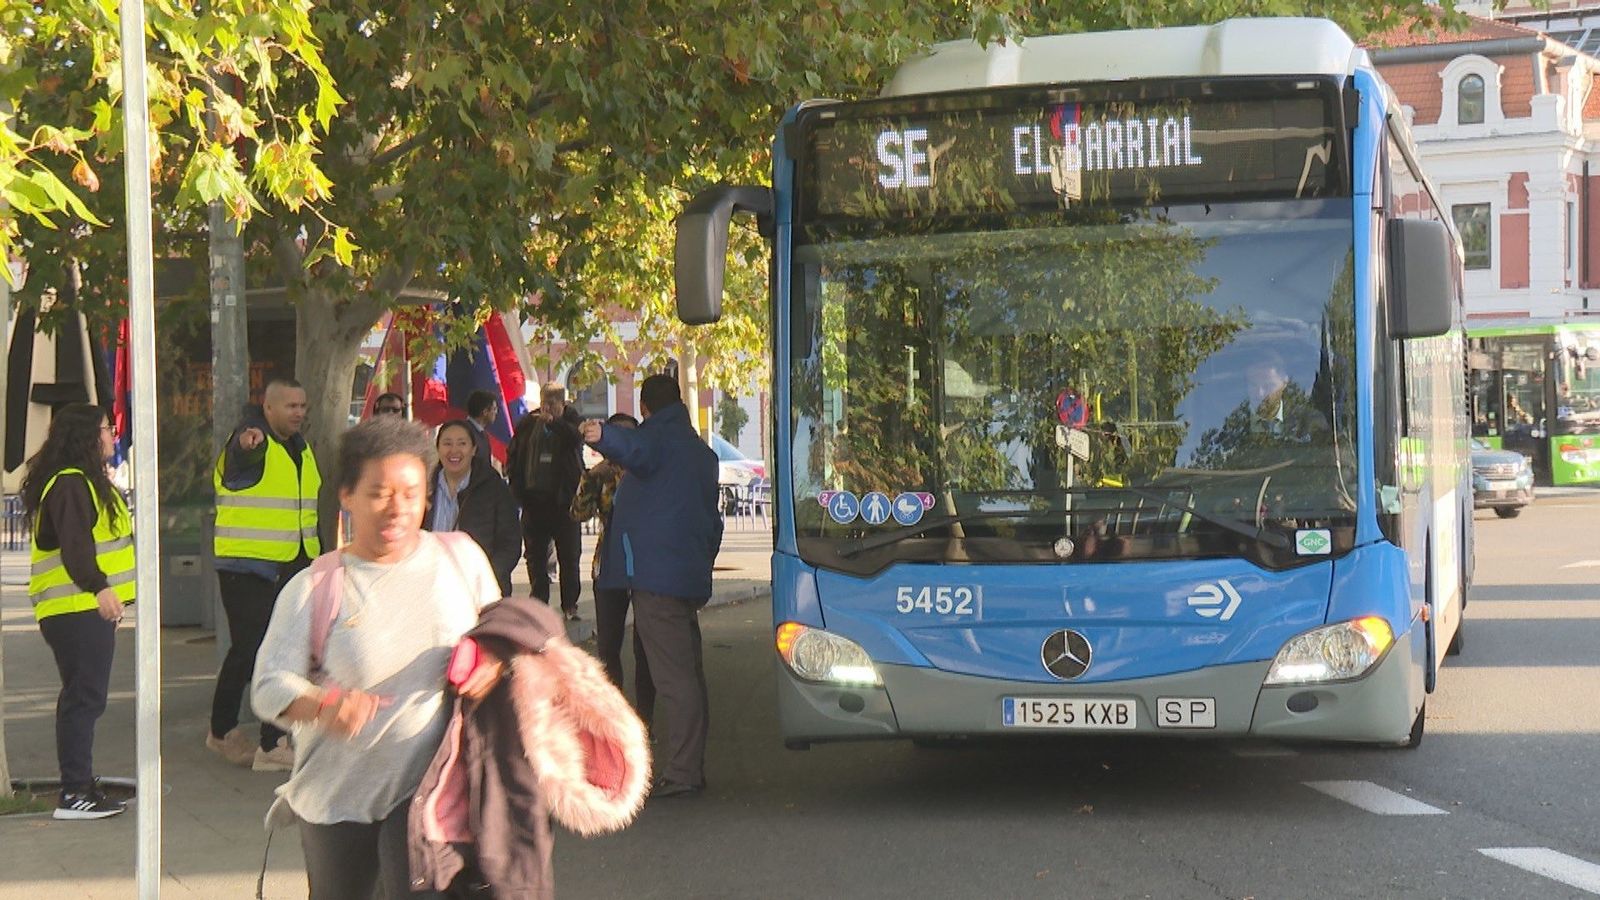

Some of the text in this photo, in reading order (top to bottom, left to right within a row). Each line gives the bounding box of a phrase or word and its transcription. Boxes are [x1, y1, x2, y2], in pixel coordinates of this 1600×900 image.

[876, 128, 930, 189] SE
[1012, 116, 1203, 175] EL BARRIAL
[896, 586, 973, 614] 5452
[1020, 701, 1129, 725] 1525 KXB
